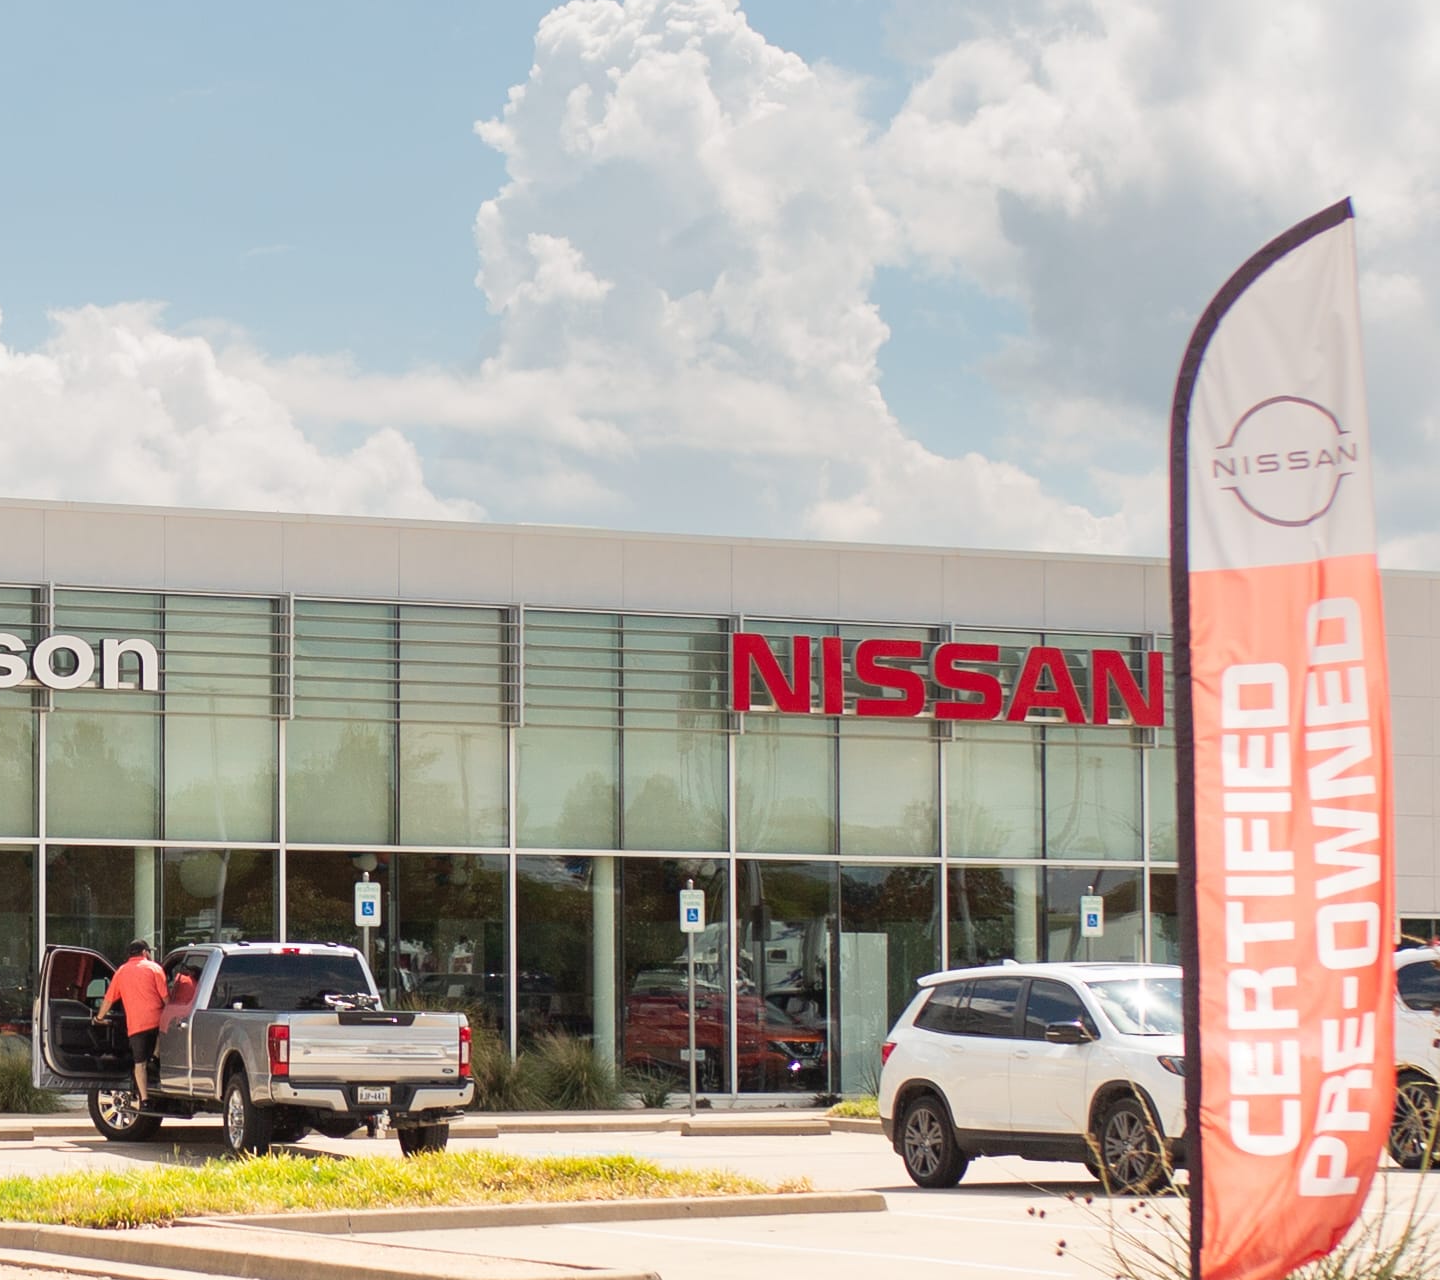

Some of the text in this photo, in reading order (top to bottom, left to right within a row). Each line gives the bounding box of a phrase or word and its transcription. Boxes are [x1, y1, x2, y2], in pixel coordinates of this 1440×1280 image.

[1212, 442, 1358, 479] NISSAN
[732, 632, 1166, 728] NISSAN
[1220, 660, 1301, 1158] CERTIFIED
[1298, 595, 1382, 1199] PRE-OWNED
